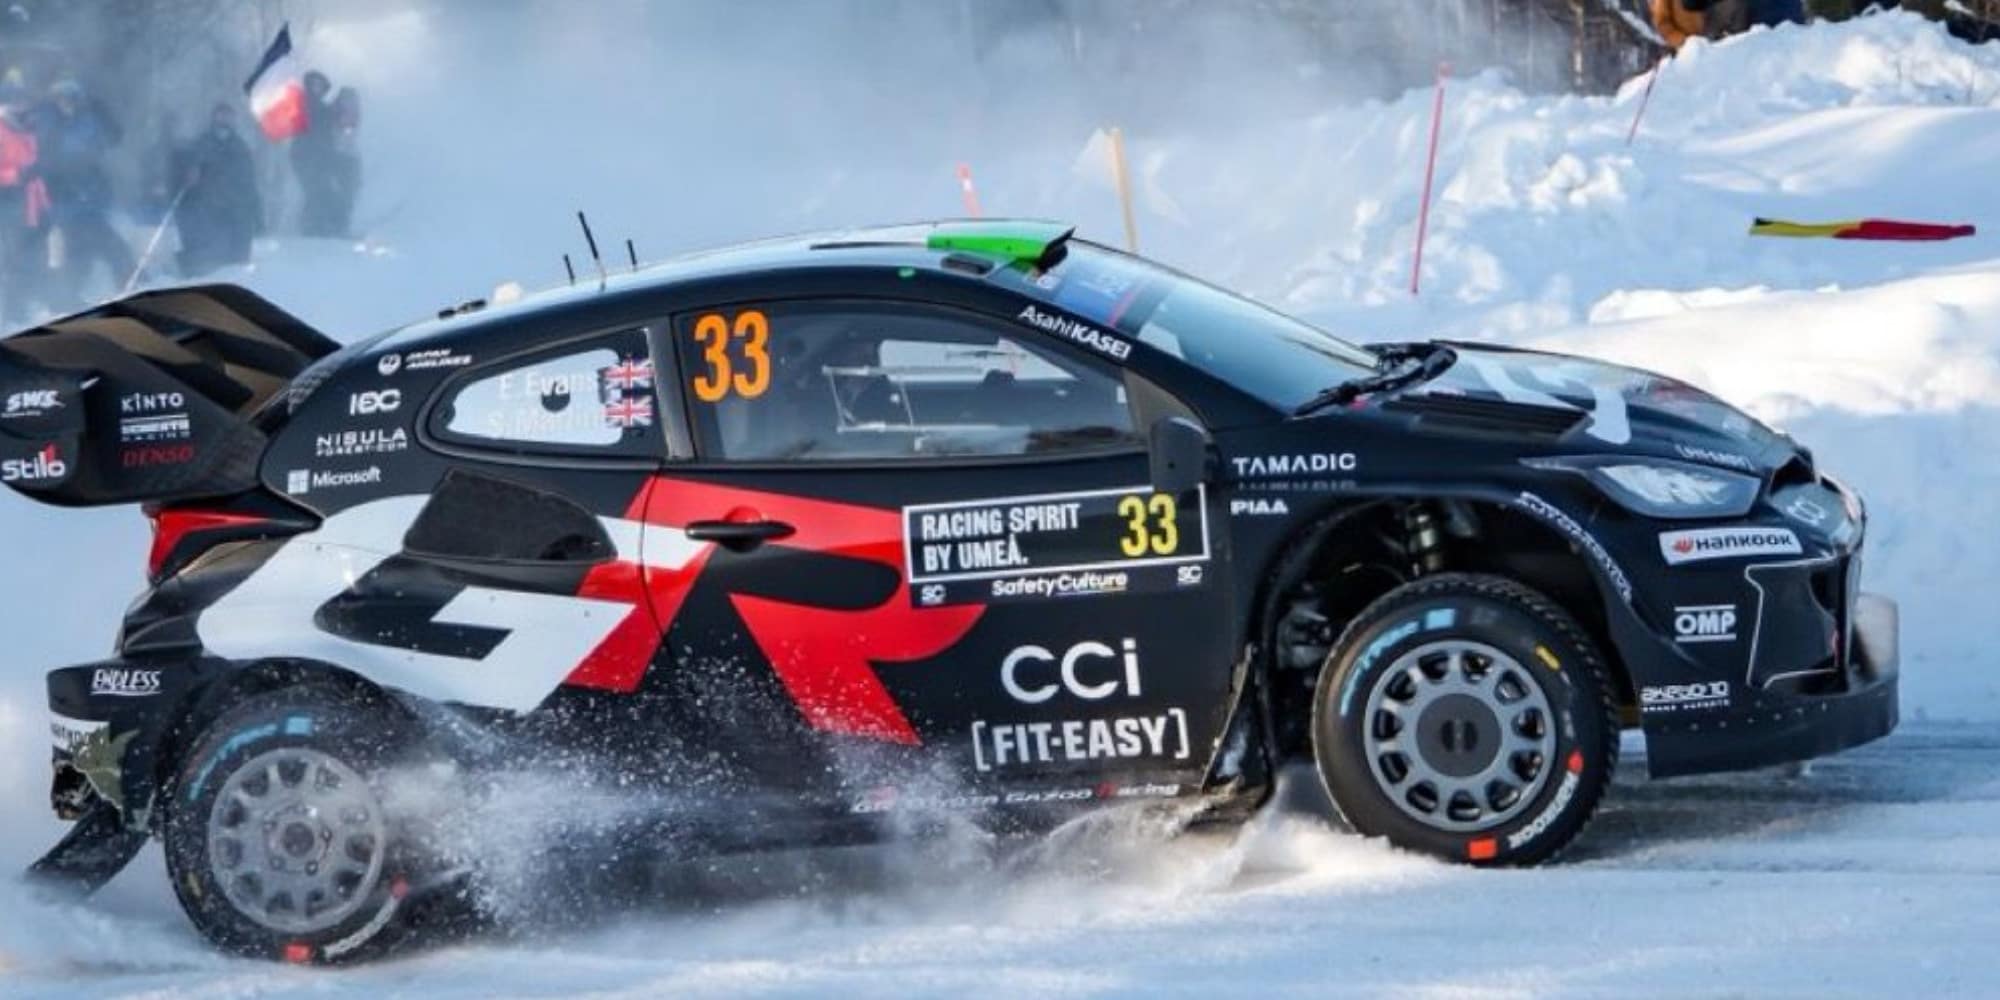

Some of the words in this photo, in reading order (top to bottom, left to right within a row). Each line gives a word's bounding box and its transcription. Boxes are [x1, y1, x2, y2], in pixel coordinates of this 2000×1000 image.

[1019, 304, 1132, 360] AsahiKASEI
[694, 311, 771, 402] 33
[121, 391, 184, 412] KINTO
[316, 427, 408, 447] NISULA
[1233, 453, 1357, 475] TAMADIC
[312, 466, 382, 487] Microsoft
[1230, 500, 1288, 515] PIAA
[921, 508, 1003, 541] RACING
[1009, 503, 1081, 534] SPIRIT
[1117, 493, 1178, 558] 33
[923, 545, 953, 572] BY
[958, 533, 1029, 570] UMEÅ.
[992, 572, 1129, 597] SafetyCulture
[1675, 611, 1737, 634] OMP
[92, 668, 162, 692] ENDLESS
